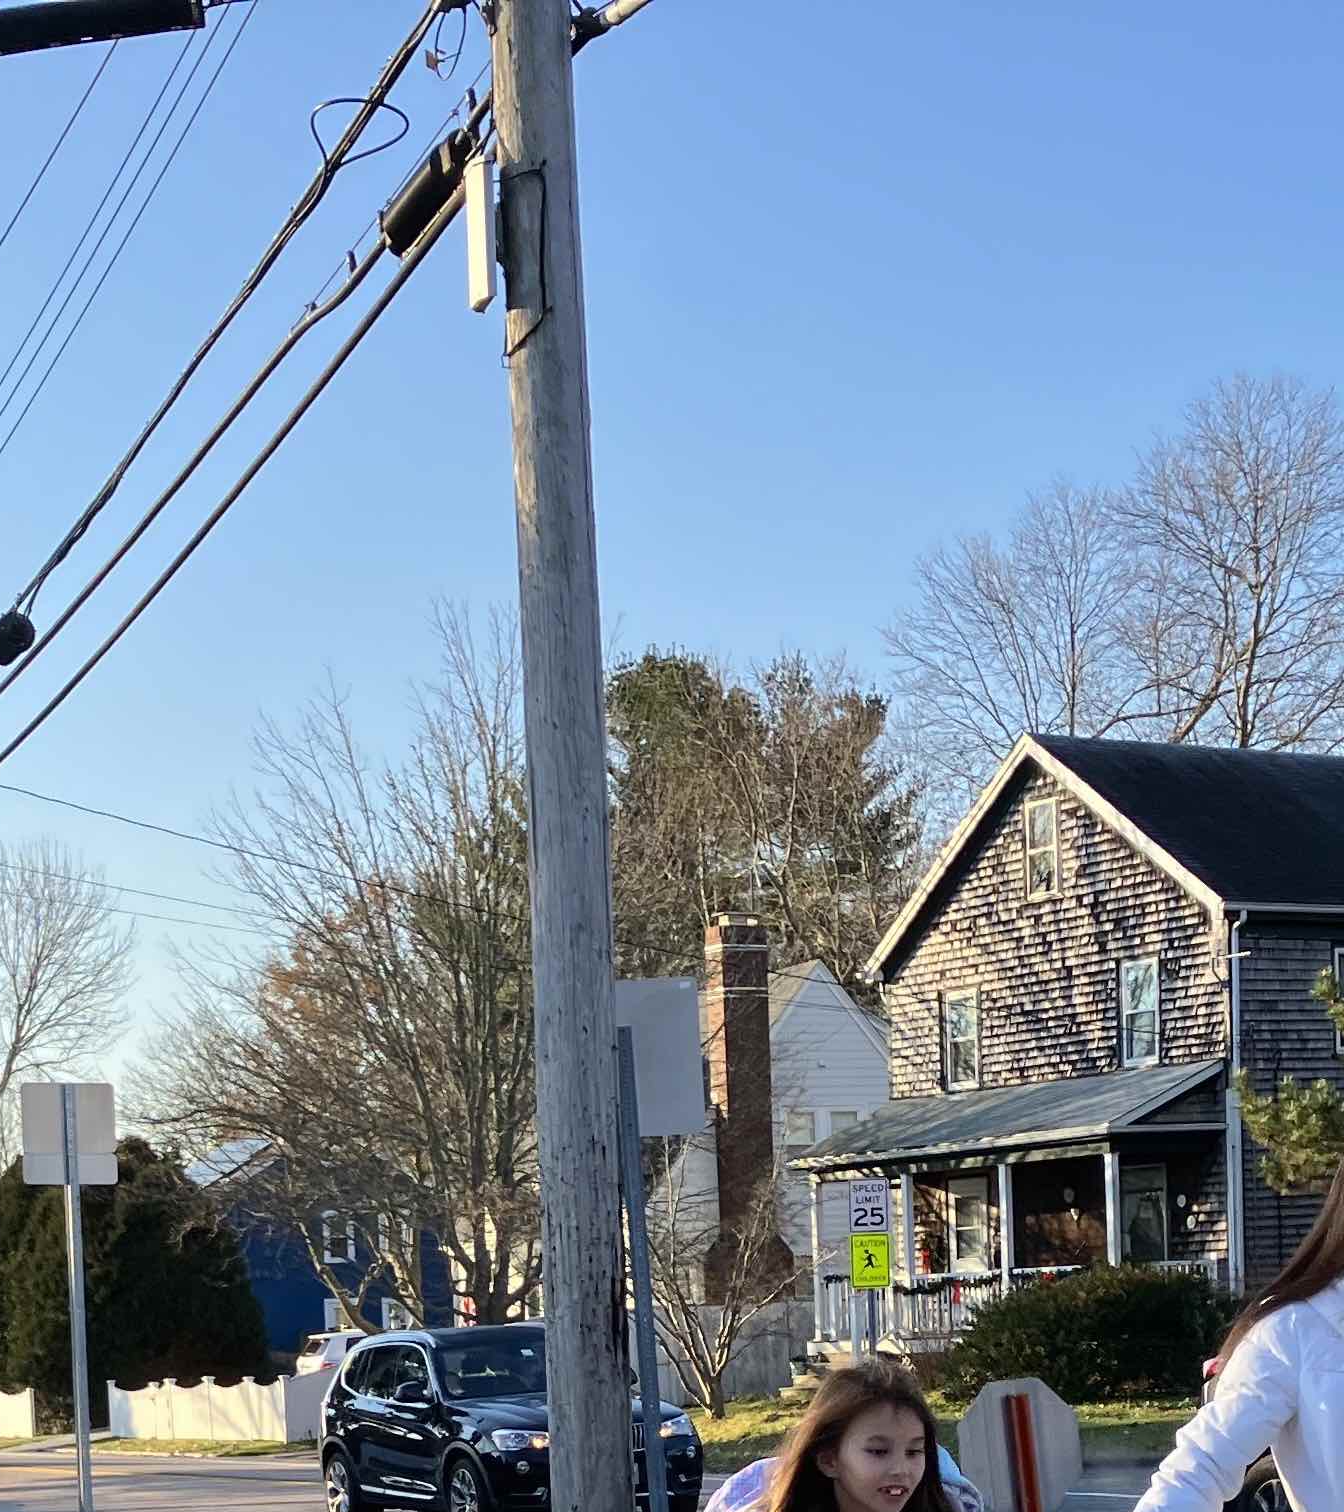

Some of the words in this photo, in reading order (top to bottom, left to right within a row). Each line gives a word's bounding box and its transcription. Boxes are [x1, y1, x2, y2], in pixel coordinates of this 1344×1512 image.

[852, 1184, 884, 1192] SPEED
[856, 1196, 880, 1204] LIMIT
[854, 1207, 884, 1226] 25
[855, 1239, 885, 1248] CAUTION
